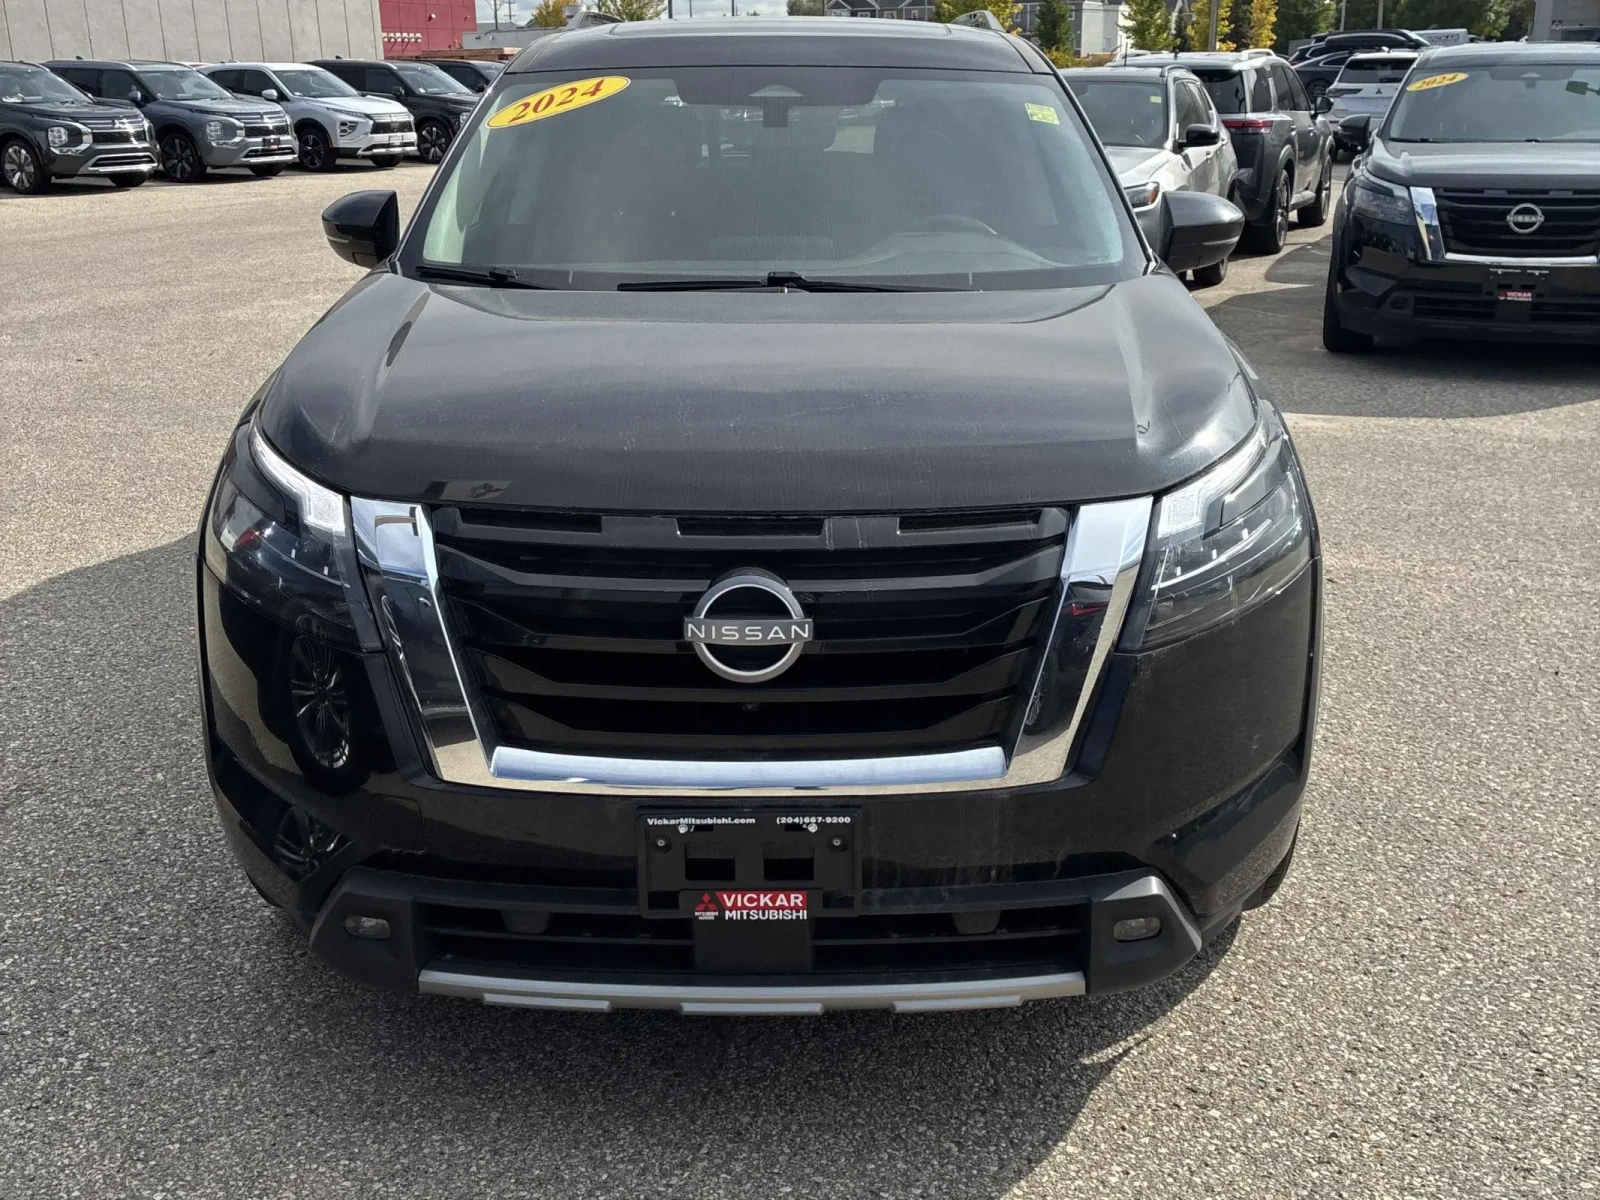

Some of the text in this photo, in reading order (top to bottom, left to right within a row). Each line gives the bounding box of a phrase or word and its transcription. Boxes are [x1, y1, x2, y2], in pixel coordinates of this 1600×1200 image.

[1415, 73, 1459, 89] 2024
[508, 78, 605, 124] 2024
[1507, 214, 1545, 223] NISSAN
[687, 623, 809, 641] NISSAN
[646, 816, 756, 826] VickarMitsubishi.com
[776, 815, 852, 826] (204)667-9200
[722, 893, 804, 908] VICKAR
[724, 909, 808, 921] MITSUBISHI
